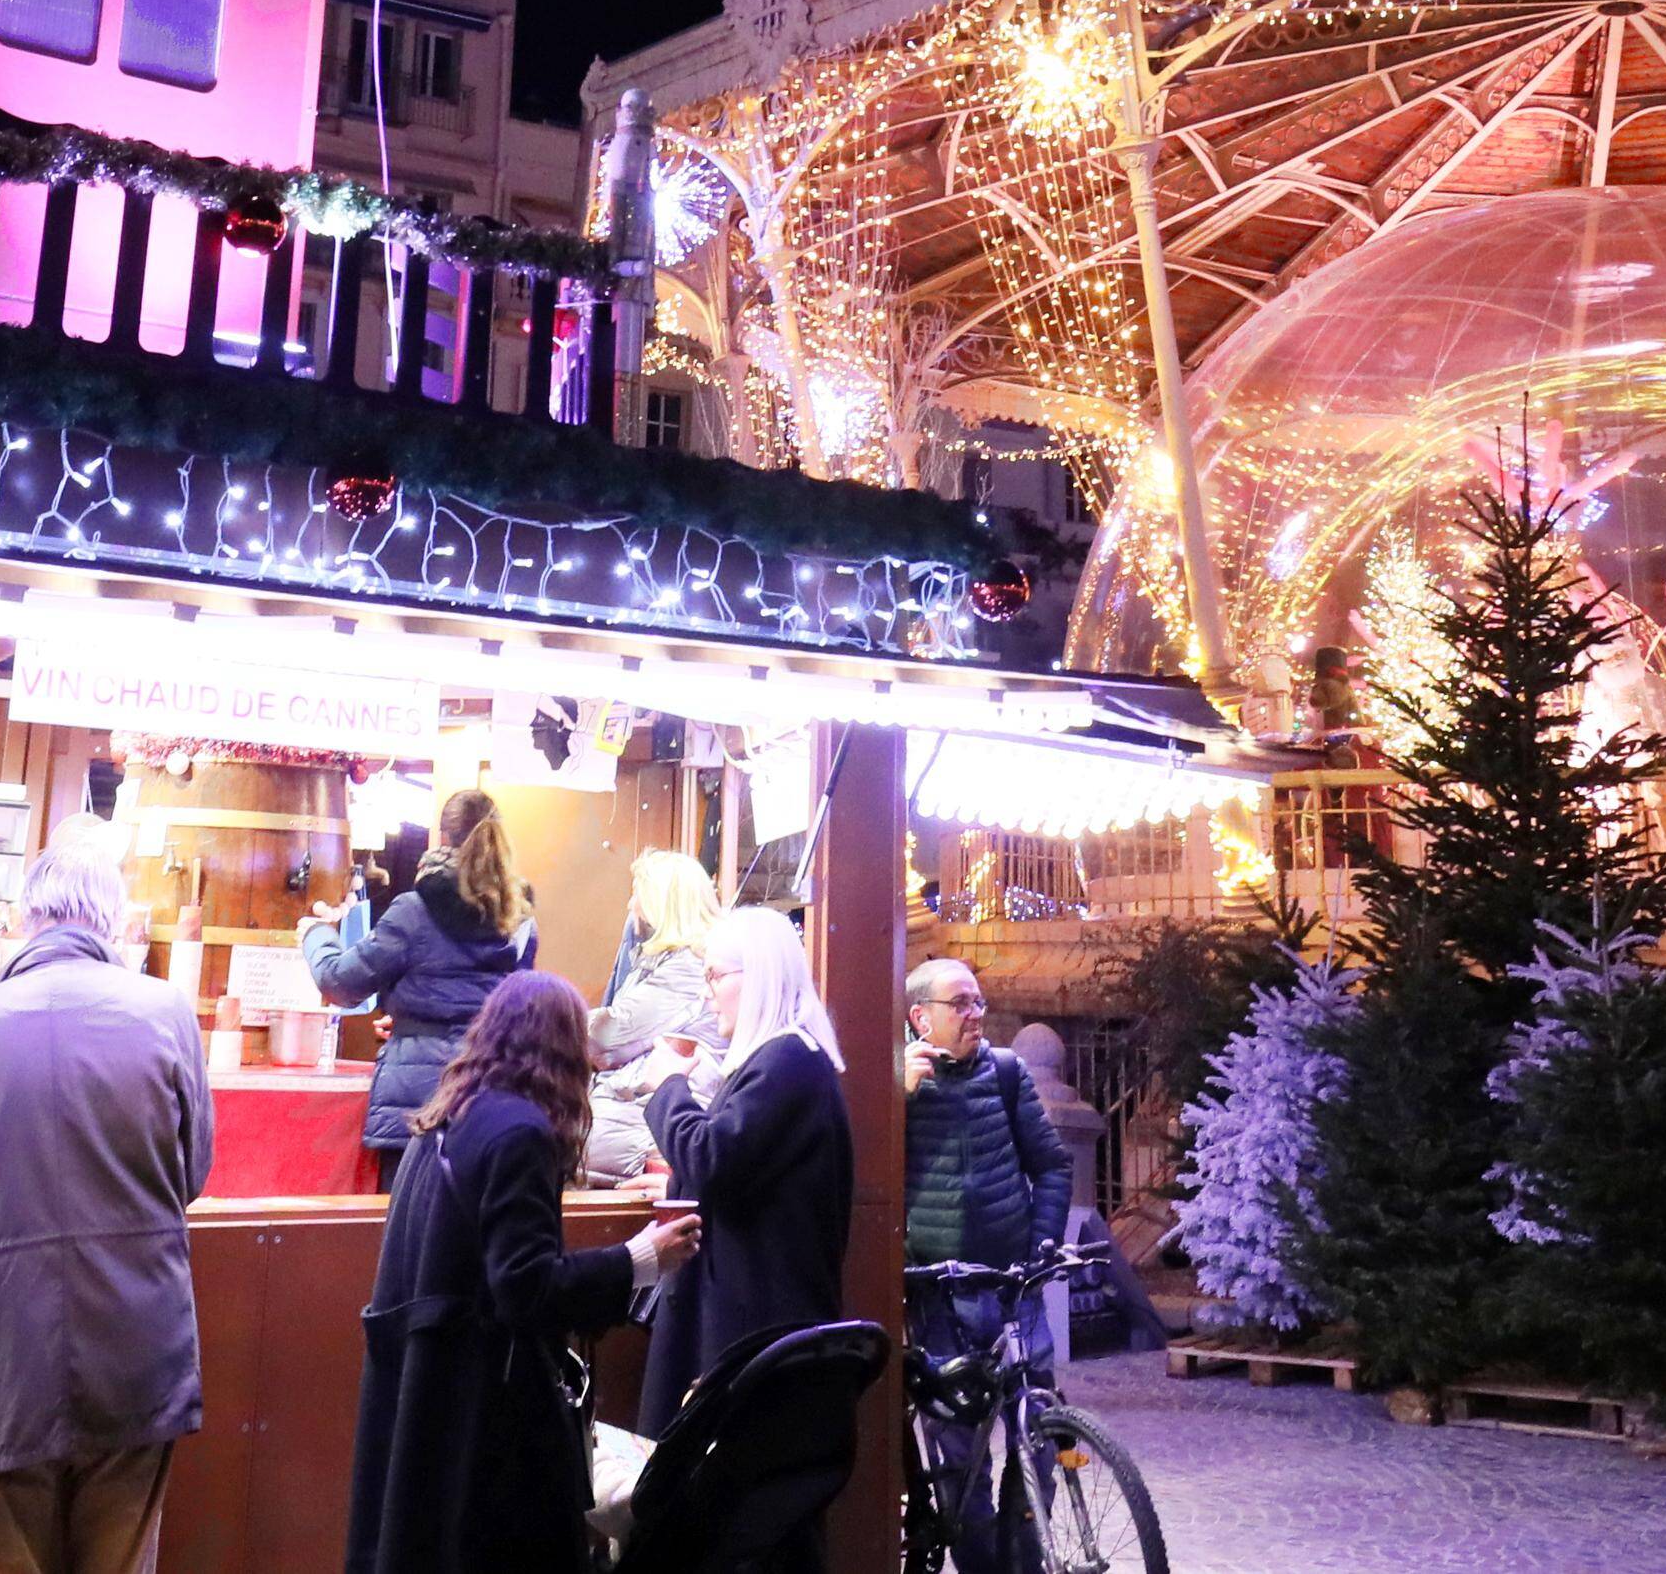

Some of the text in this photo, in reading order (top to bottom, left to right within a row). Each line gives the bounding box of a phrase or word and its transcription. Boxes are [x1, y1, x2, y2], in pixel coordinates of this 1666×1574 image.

[21, 666, 422, 736] VIN CHAUD DE CANNES
